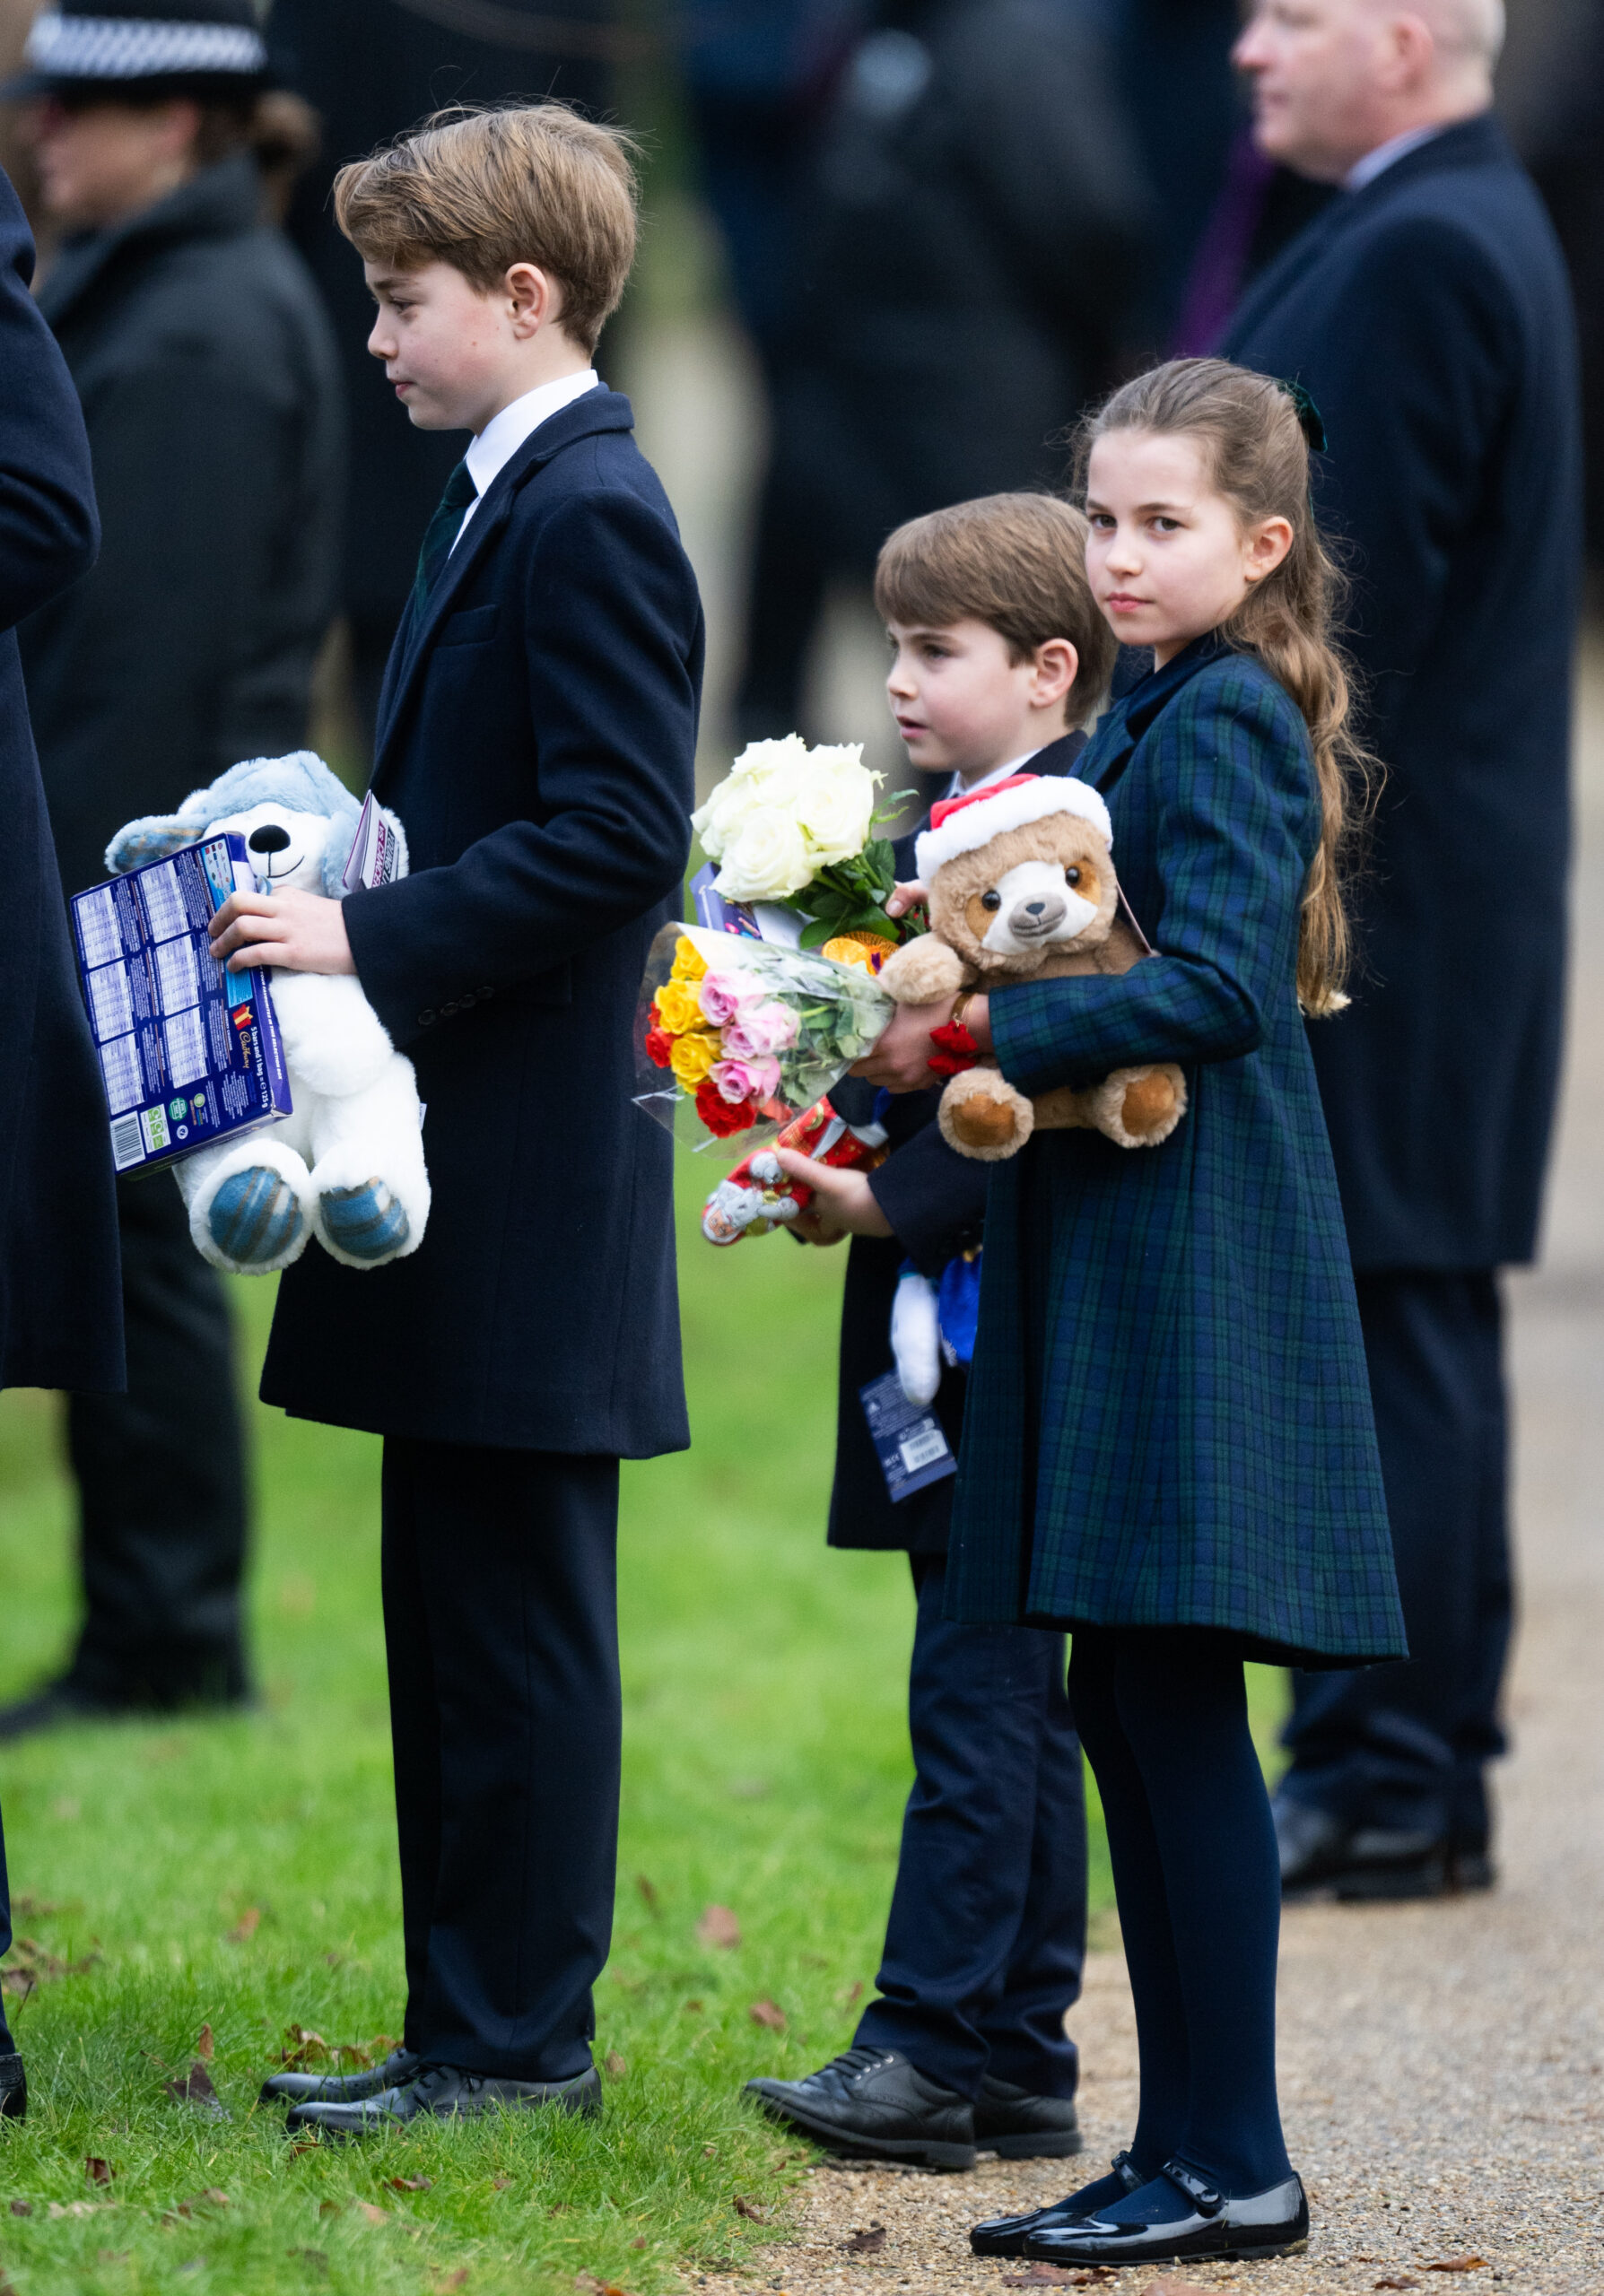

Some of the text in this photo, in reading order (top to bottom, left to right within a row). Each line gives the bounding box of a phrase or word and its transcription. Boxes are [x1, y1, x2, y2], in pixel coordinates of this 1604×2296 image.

[379, 825, 385, 842] VS
[384, 831, 395, 874] YOUNG
[262, 986, 271, 1018] FAVOURITES
[271, 1038, 280, 1068] SELECTION
[251, 1031, 260, 1046] bars
[239, 1031, 252, 1069] Cadbury
[254, 1046, 262, 1058] and
[255, 1063, 265, 1076] bag
[261, 1091, 269, 1102] 125
